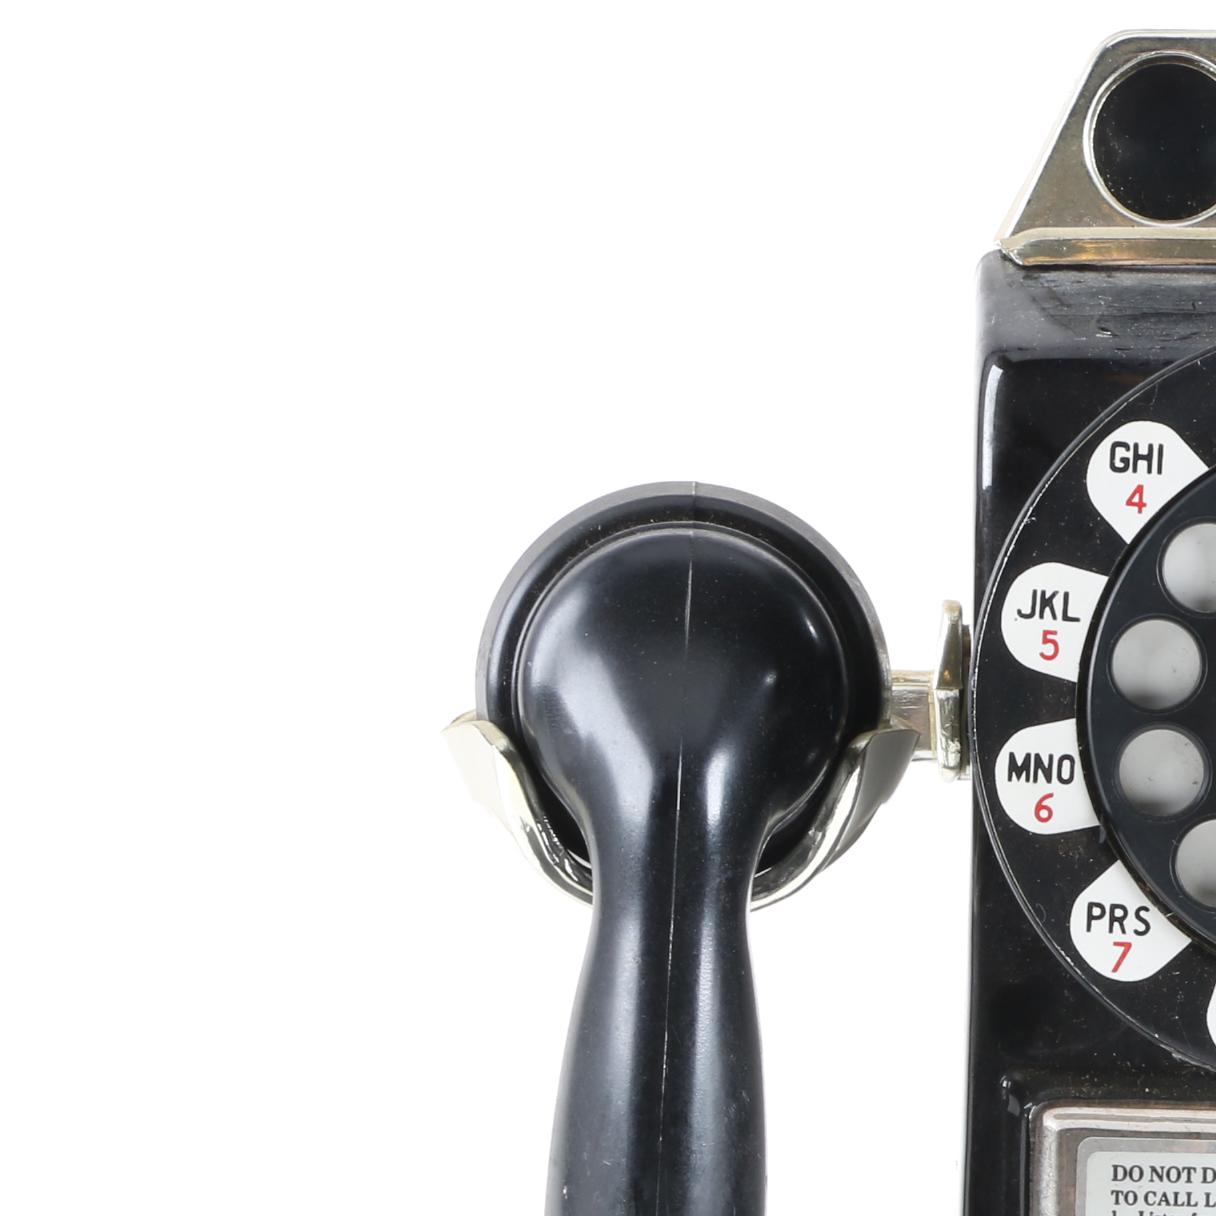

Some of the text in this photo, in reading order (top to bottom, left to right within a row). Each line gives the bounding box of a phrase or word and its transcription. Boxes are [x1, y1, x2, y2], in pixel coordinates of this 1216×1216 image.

[1108, 442, 1164, 476] GHI
[1125, 484, 1148, 515] 4
[1017, 589, 1081, 623] JKL
[1039, 630, 1059, 661] 5
[1007, 754, 1076, 785] MNO
[1034, 793, 1054, 823] 6
[1086, 903, 1151, 938] PRS
[1111, 942, 1133, 973] 7
[1111, 1165, 1144, 1183] DO
[1149, 1166, 1196, 1184] NOT
[1111, 1190, 1138, 1205] TO
[1144, 1191, 1198, 1207] CALL
